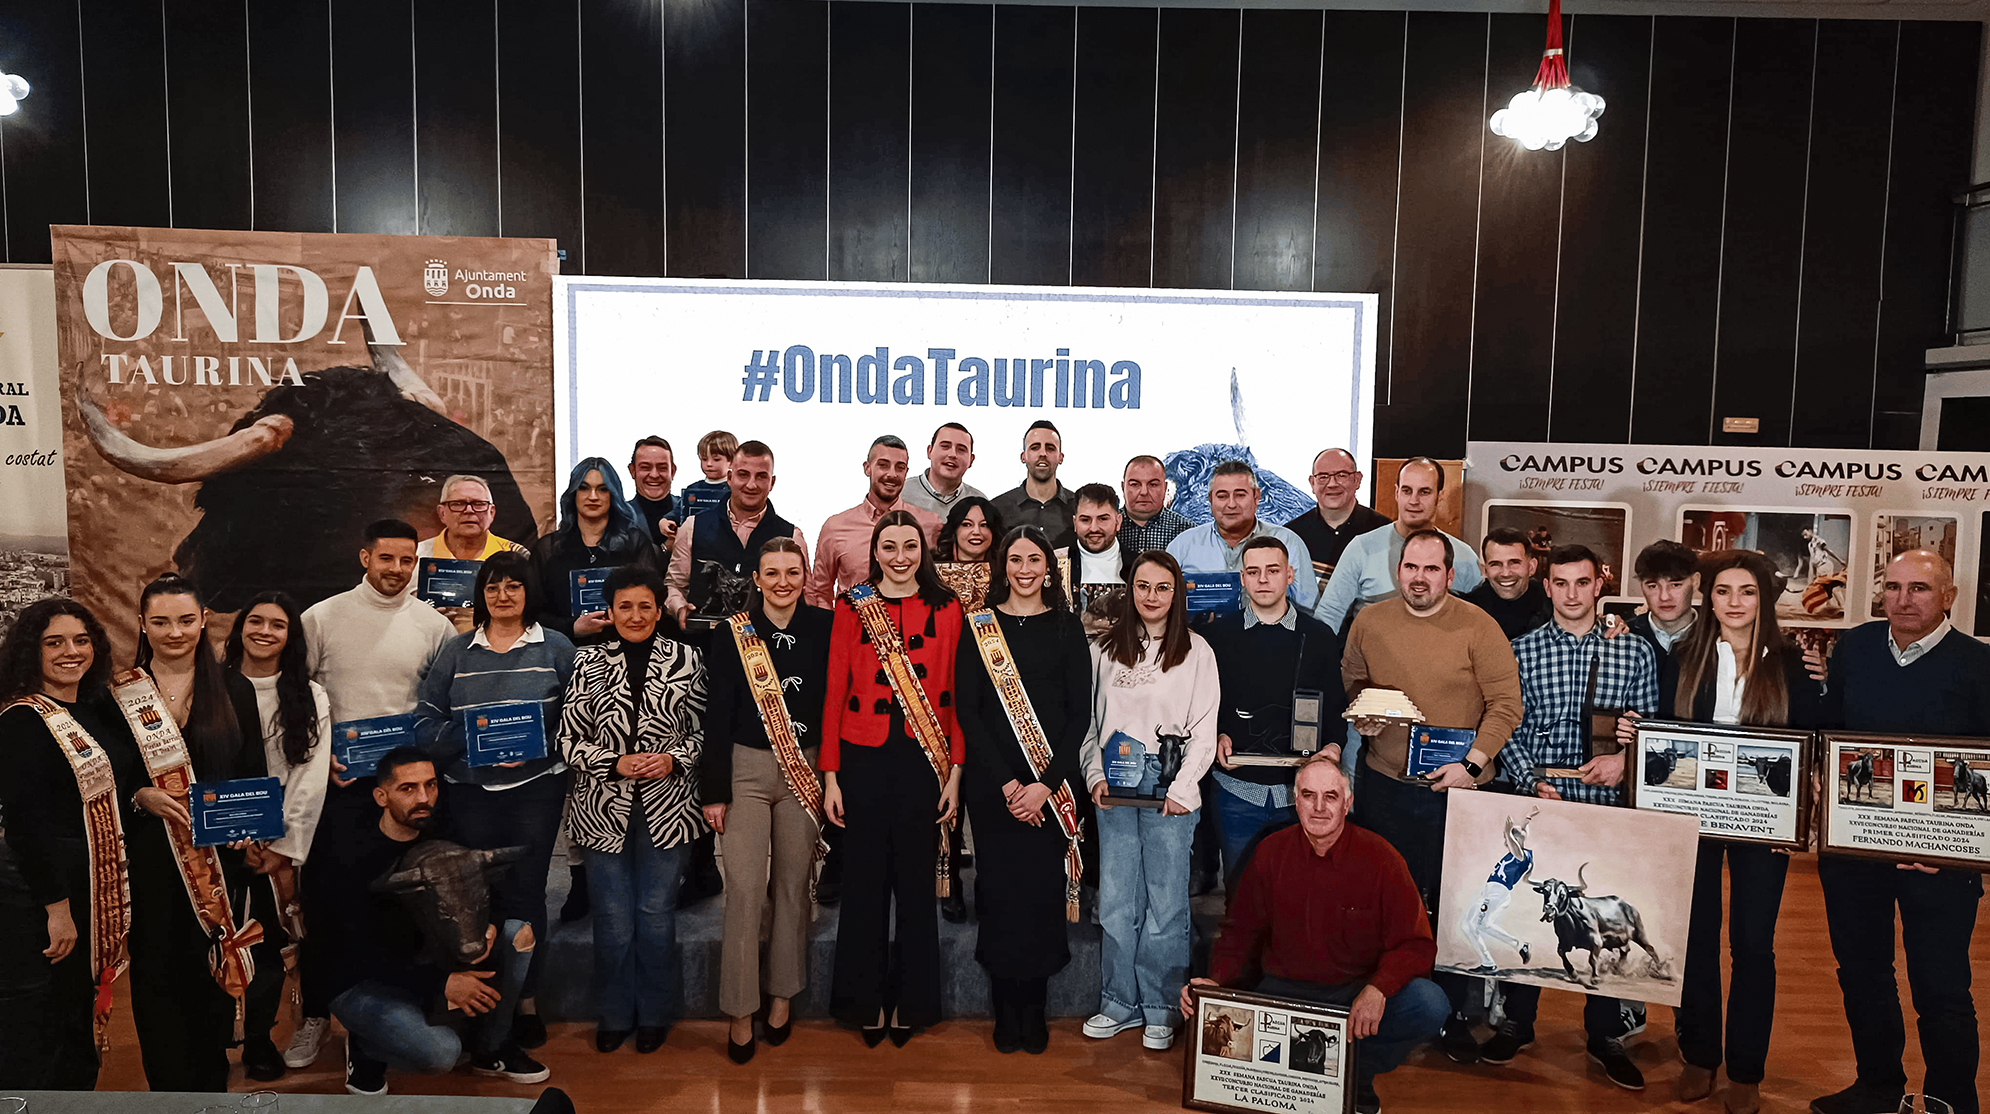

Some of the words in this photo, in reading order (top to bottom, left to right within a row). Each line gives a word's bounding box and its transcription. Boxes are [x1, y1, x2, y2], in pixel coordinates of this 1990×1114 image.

[454, 268, 527, 283] Ajuntament
[466, 283, 516, 299] Onda
[82, 259, 407, 345] ONDA
[100, 353, 306, 387] TAURINA
[742, 344, 1142, 410] #OndaTaurina
[5, 449, 58, 467] costat
[1500, 454, 1624, 474] CAMPUS
[1636, 457, 1763, 477] CAMPUS
[1775, 460, 1903, 481] CAMPUS
[1700, 807, 1730, 815] NACIONAL
[1710, 822, 1775, 835] BENAVENT
[1874, 815, 1900, 823] SEMANA
[1900, 818, 1924, 826] PASCUA
[1925, 819, 1954, 828] TAURINA
[1898, 824, 1931, 833] NACIONAL
[1862, 828, 1893, 837] PRIMER
[1895, 831, 1950, 842] CLASIFICADO
[1852, 835, 1904, 847] FERNANDO
[1906, 840, 1981, 854] MACHANCOSES
[1225, 1076, 1254, 1087] CONCURSO
[1254, 1082, 1282, 1092] NACIONAL
[1233, 1071, 1256, 1081] SEMANA
[1256, 1075, 1277, 1084] PASCUA
[1278, 1079, 1302, 1088] TAURINA
[1302, 1083, 1319, 1091] ONDA
[1222, 1084, 1248, 1094] TERCER
[1250, 1088, 1297, 1101] CLASIFICADO
[1234, 1093, 1249, 1103] LA
[1252, 1096, 1297, 1111] PALOMA
